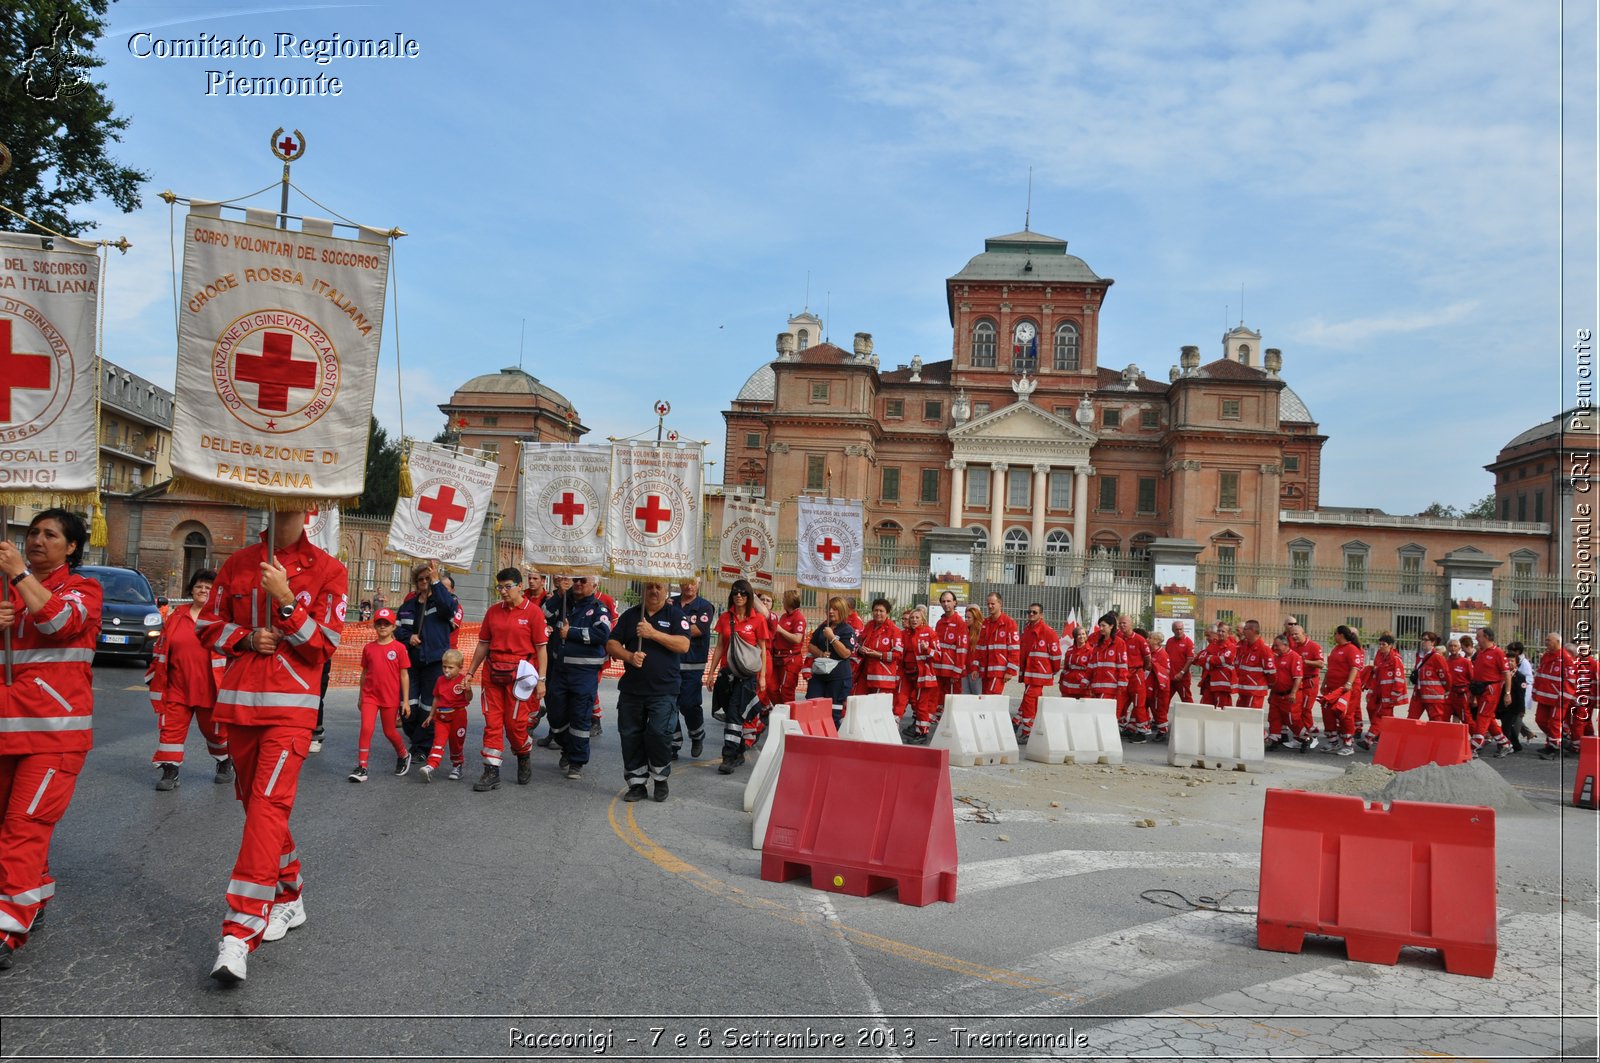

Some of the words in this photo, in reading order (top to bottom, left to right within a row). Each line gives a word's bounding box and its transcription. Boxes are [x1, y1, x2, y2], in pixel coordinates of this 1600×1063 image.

[194, 228, 229, 247] CORPO
[234, 236, 293, 258] VOLONTARI
[297, 246, 317, 261] DEL
[322, 250, 379, 270] SOCCORSO
[5, 258, 27, 271] DEL
[23, 277, 96, 294] ITALIANA
[188, 273, 239, 313] CROCE
[245, 268, 304, 286] ROSSA
[312, 279, 373, 337] ITALIANA
[5, 301, 19, 312] DI
[24, 309, 67, 357] GINEVRA
[240, 319, 253, 332] DI
[255, 314, 310, 335] GINEVRA
[310, 331, 326, 346] 22
[216, 327, 242, 410] CONVENZIONE
[320, 347, 337, 397] AGOSTO
[304, 398, 328, 419] 1864
[0, 450, 58, 462] OCALE
[65, 451, 77, 462] DI
[201, 434, 315, 463] DELEGAZIONE
[322, 451, 339, 464] DI
[0, 469, 56, 482] ONIGI
[216, 463, 313, 489] PAESANA
[410, 460, 434, 473] CROCE
[436, 468, 463, 479] ROSSA
[463, 474, 492, 488] ITALIANA
[529, 464, 551, 472] CROCE
[553, 464, 576, 472] ROSSA
[579, 464, 608, 473] ITALIANA
[612, 476, 633, 506] CROCE
[634, 469, 666, 481] ROSSA
[667, 473, 697, 511] ITALIANA
[643, 483, 673, 497] GINEVRA
[404, 533, 452, 552] DELEGAZIONE
[404, 541, 457, 560] PEVERAGNO
[532, 545, 566, 553] COMITATO
[607, 556, 634, 565] BORGO
[647, 559, 692, 570] DALMAZZO
[612, 548, 647, 558] COMITATO
[650, 551, 680, 559] LOCALE
[681, 552, 689, 560] DI
